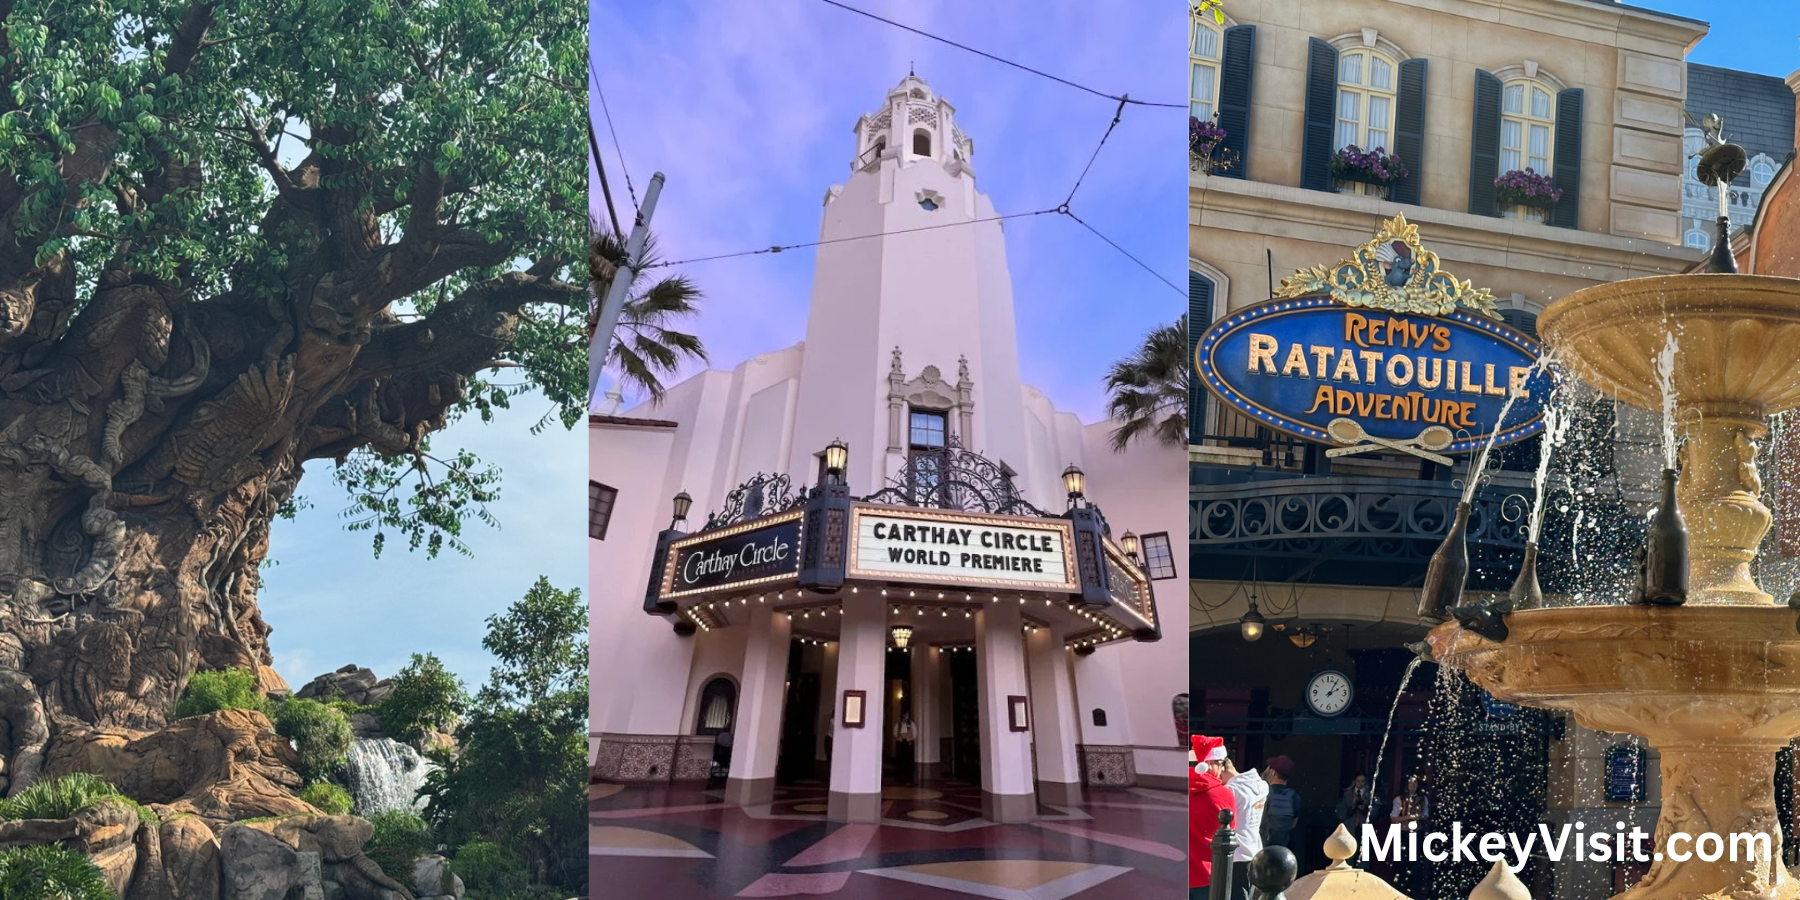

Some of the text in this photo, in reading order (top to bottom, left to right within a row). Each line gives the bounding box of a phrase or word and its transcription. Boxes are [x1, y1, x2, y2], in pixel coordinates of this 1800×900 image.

[1345, 312, 1451, 351] REMY'S
[1247, 333, 1531, 400] RATATOUILLE
[1303, 384, 1477, 429] ADVENTURE
[873, 522, 1053, 552] CARTHAY CIRCLE
[684, 549, 739, 584] Carthay
[740, 535, 789, 567] Circle
[888, 547, 1043, 573] WORLD PREMIERE
[1312, 689, 1318, 697] 9
[1326, 675, 1335, 683] 12
[1341, 689, 1347, 697] 3
[1326, 703, 1332, 711] 6
